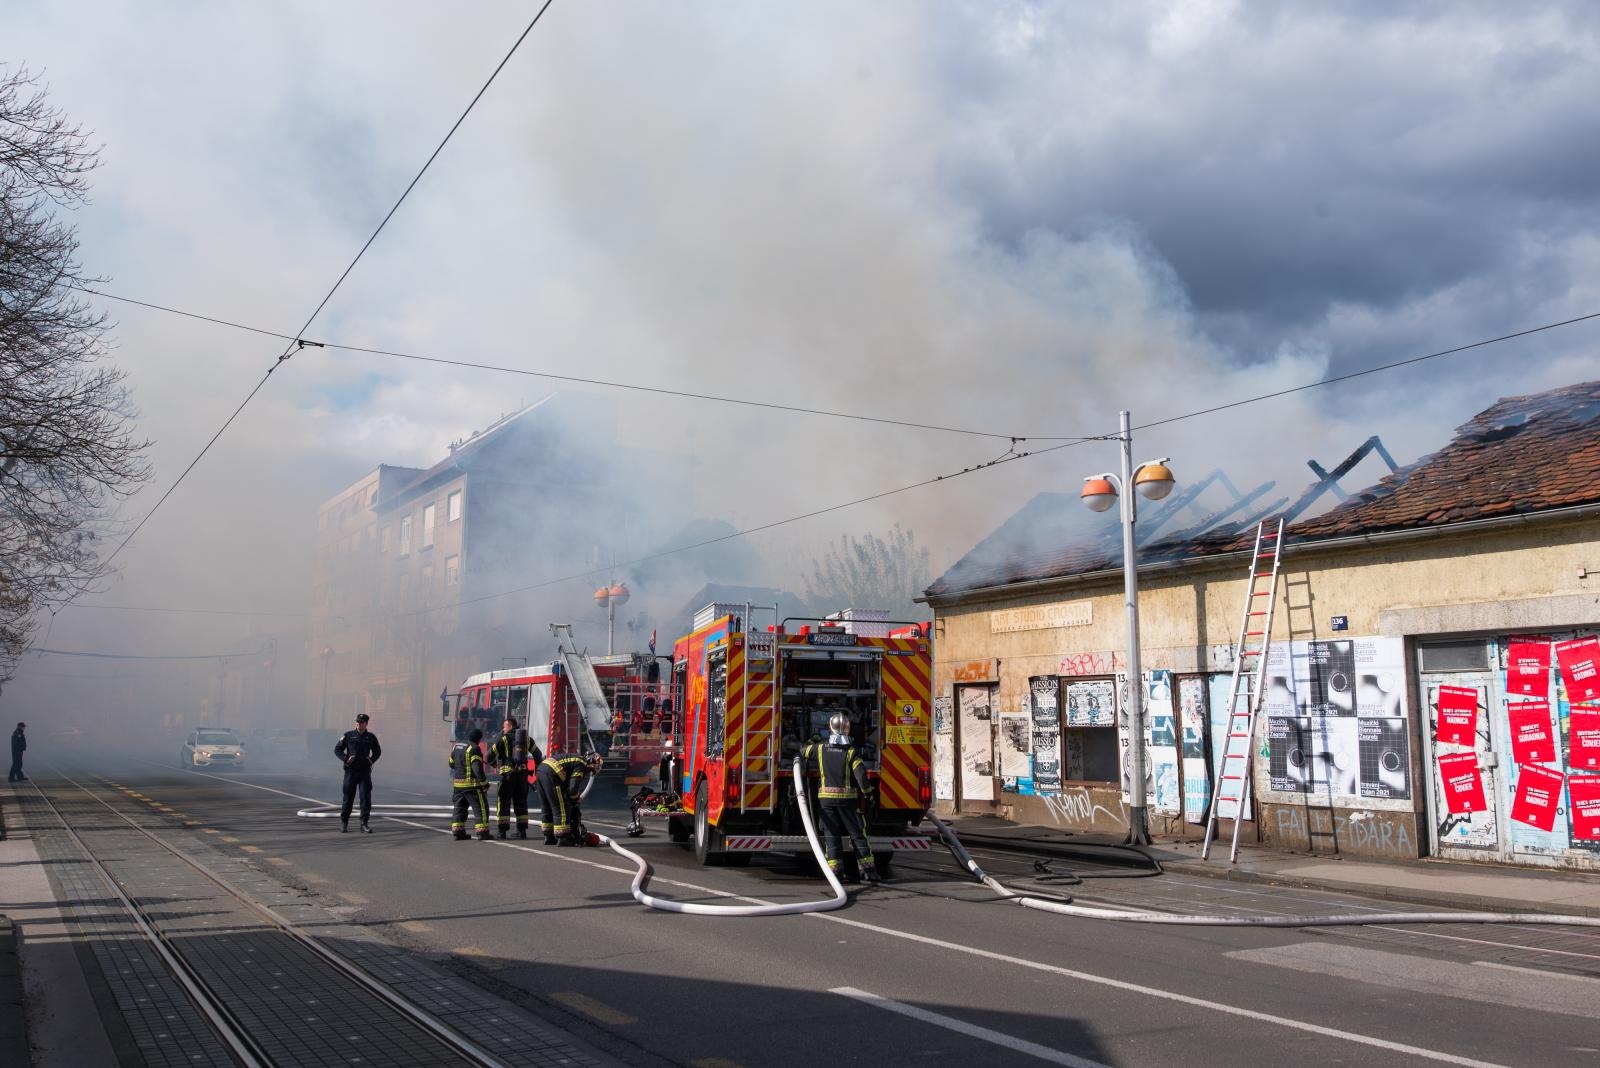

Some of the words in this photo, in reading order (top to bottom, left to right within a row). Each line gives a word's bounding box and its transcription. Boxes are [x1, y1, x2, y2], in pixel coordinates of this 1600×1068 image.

[1013, 609, 1045, 622] STUDIO
[1031, 680, 1059, 689] MISSION
[1033, 737, 1056, 747] MISSIO
